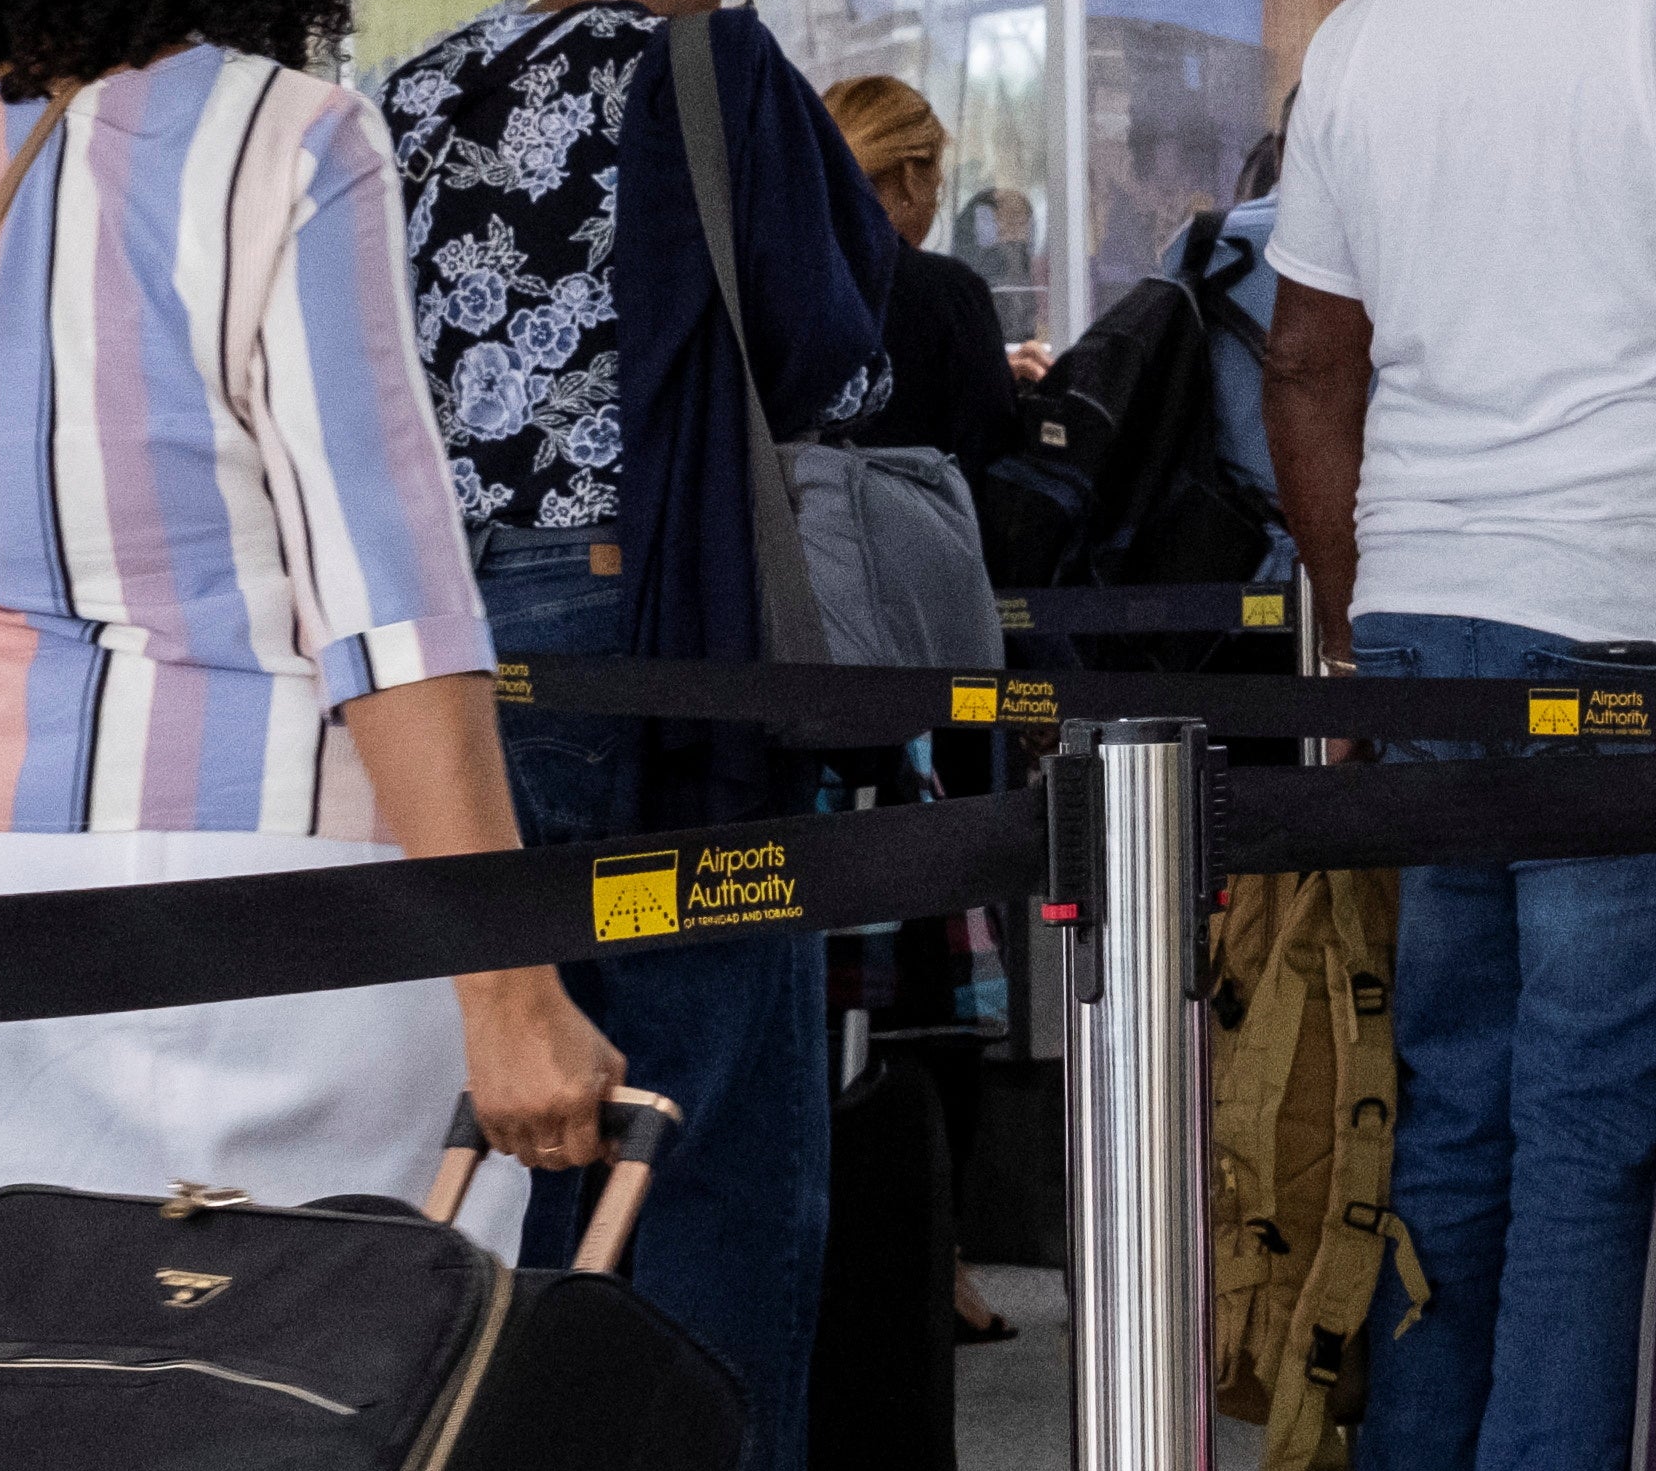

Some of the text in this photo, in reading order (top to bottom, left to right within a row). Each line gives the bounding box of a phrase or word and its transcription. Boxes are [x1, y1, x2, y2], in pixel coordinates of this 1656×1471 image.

[1005, 679, 1055, 697] Airports
[1589, 689, 1644, 708] Airports
[1001, 697, 1059, 717] Authority
[1584, 708, 1649, 730] Authority
[695, 840, 786, 878] Airports
[687, 873, 796, 910] Authority
